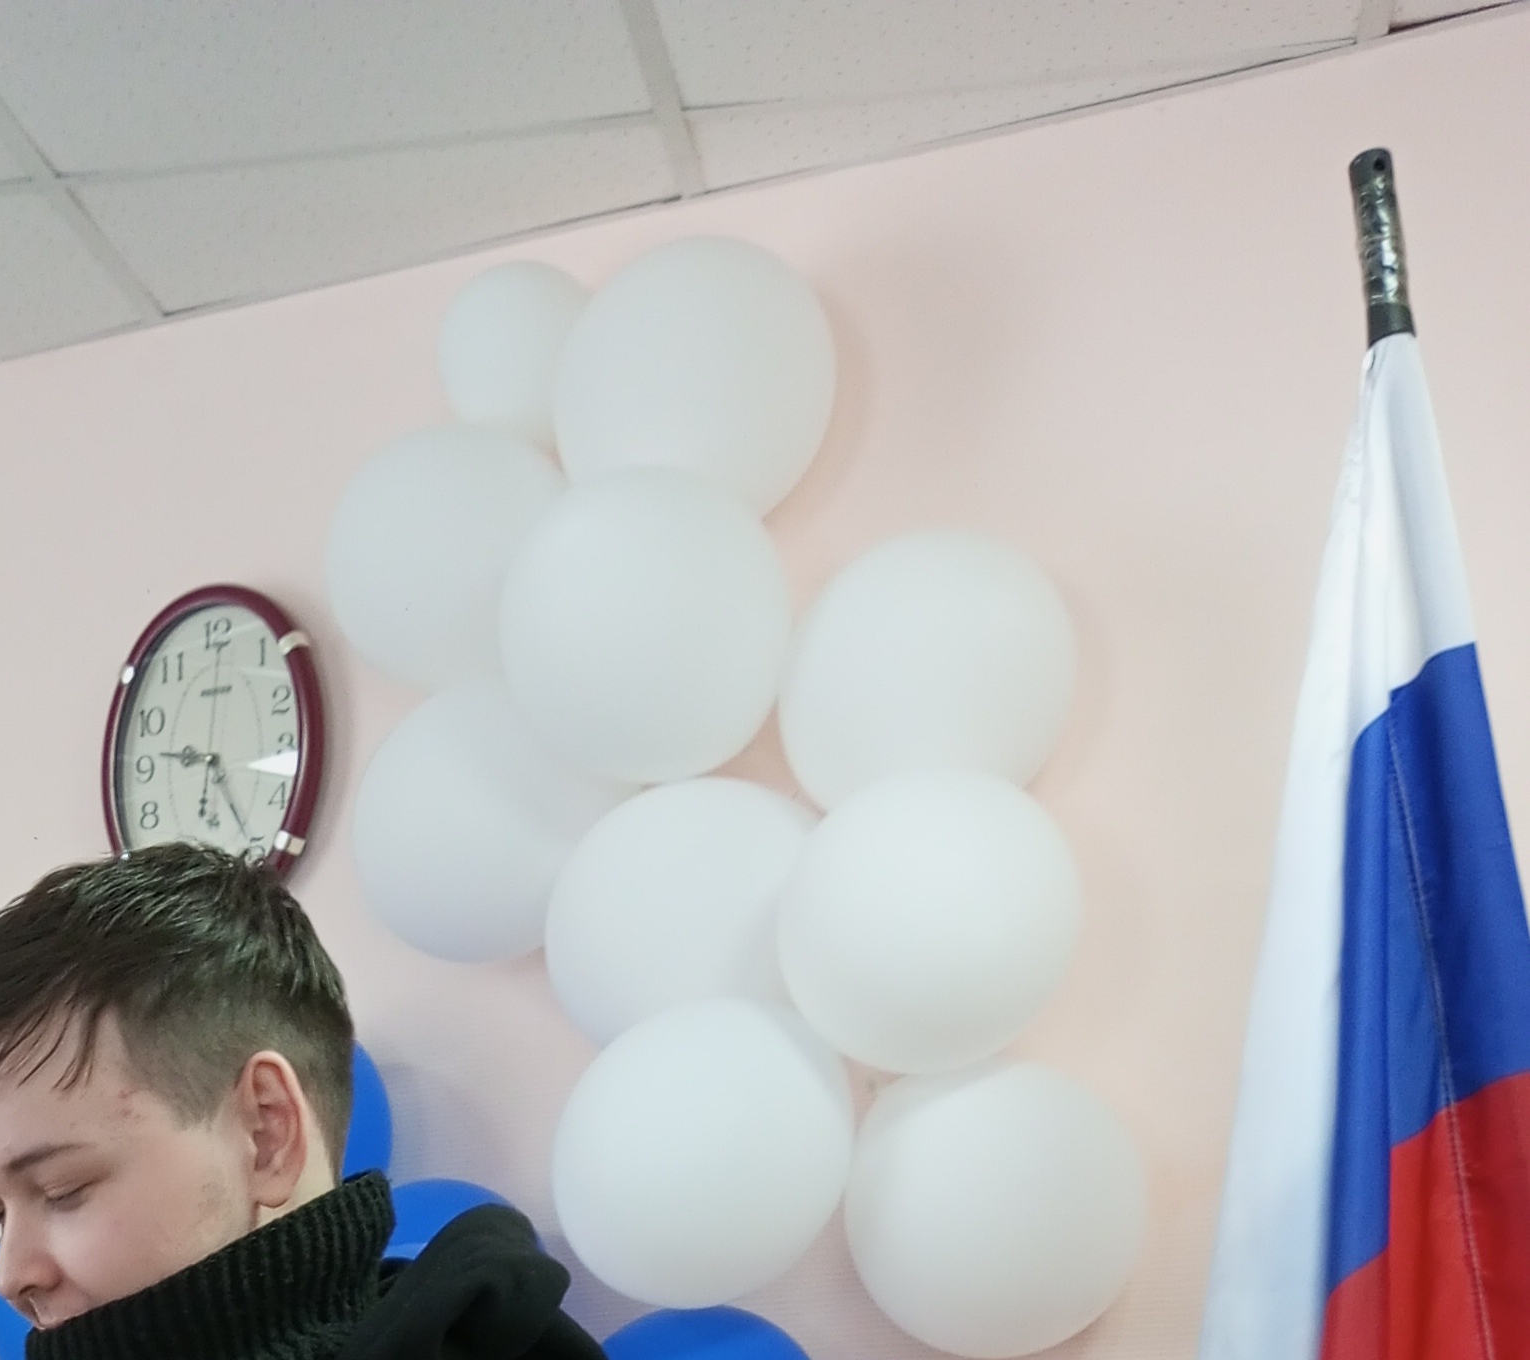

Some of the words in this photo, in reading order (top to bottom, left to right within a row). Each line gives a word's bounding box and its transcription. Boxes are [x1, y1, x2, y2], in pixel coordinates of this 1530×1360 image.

[204, 617, 232, 650] 12
[258, 637, 266, 666] 1
[161, 651, 185, 684] 11
[271, 684, 292, 714] 2
[139, 706, 166, 737] 10
[135, 754, 155, 783] 9
[268, 781, 287, 810] 4
[139, 801, 160, 829] 8
